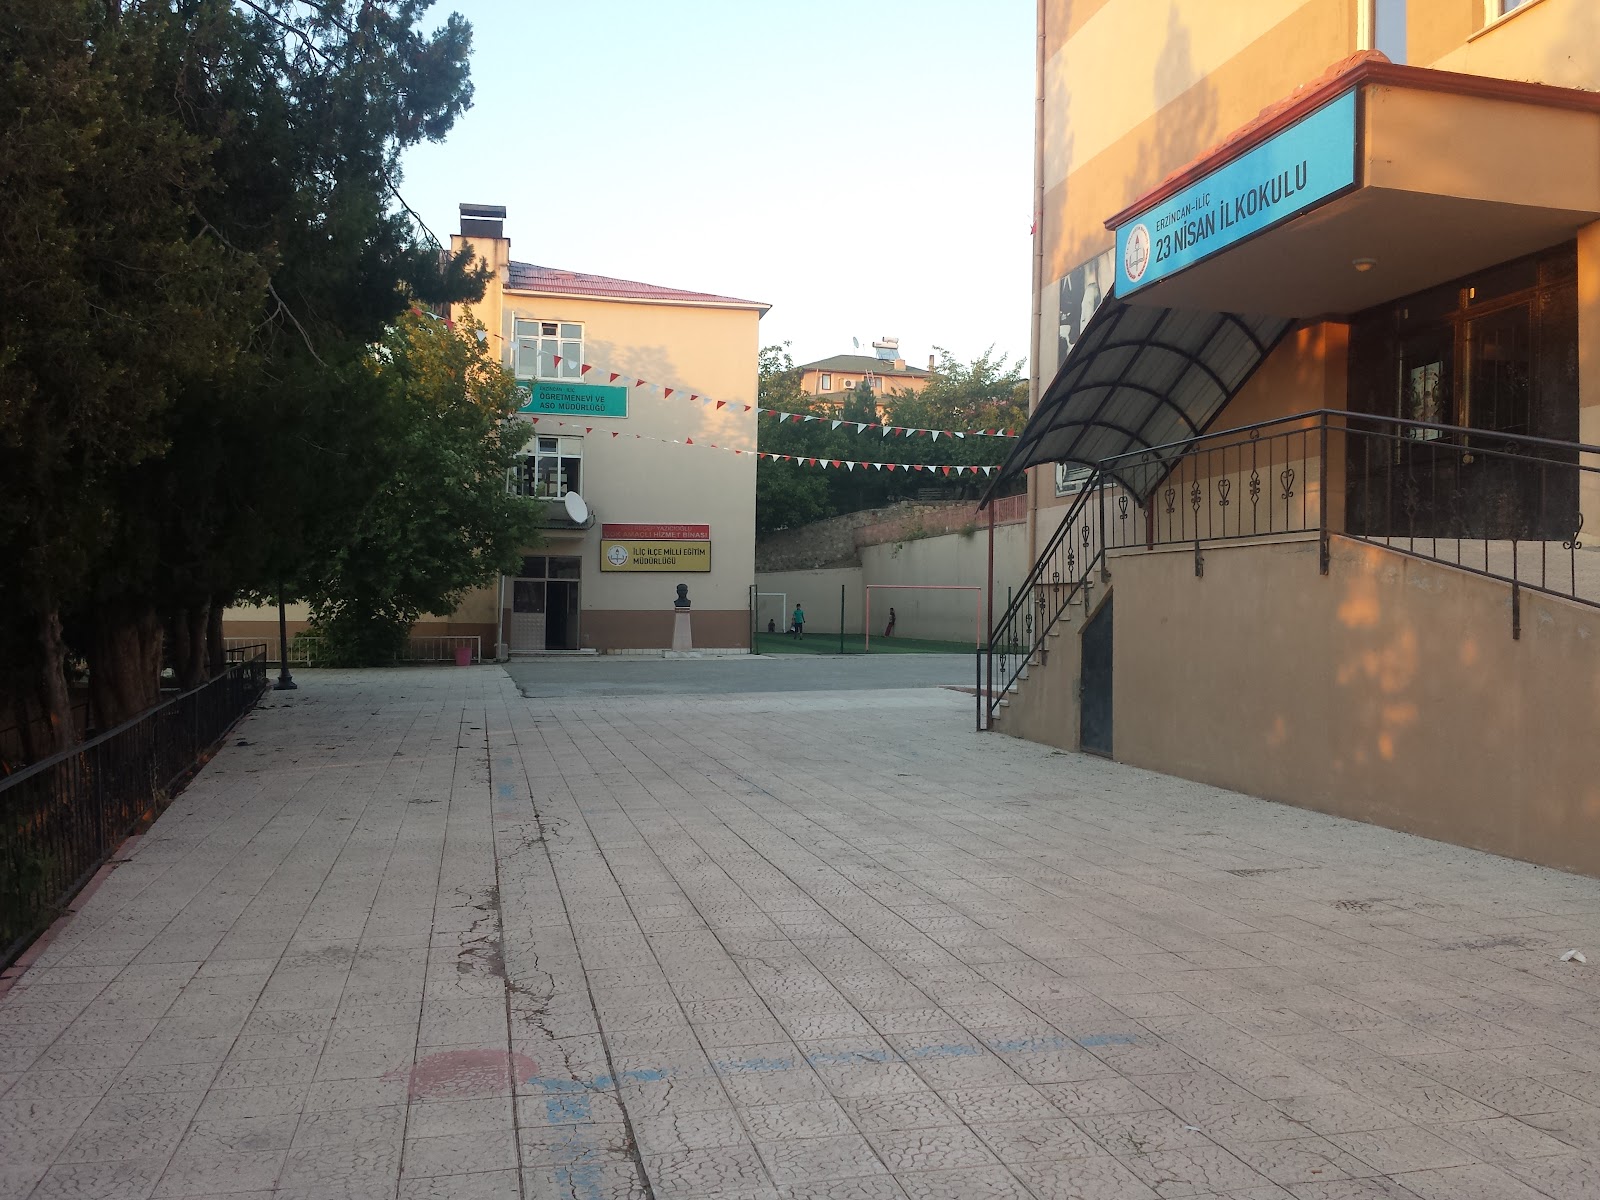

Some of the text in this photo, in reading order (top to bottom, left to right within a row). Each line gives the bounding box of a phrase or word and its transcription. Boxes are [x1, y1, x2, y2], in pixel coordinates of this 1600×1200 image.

[1155, 234, 1171, 264] 23
[1174, 209, 1215, 254] NİSAN
[1220, 160, 1307, 231] İLKOKULU
[540, 393, 593, 402] ÖĞRETMENEVİ
[558, 402, 605, 411] MÜDÜRLÜĞÜ
[682, 531, 708, 539] BİNASI
[633, 548, 646, 556] İLİÇ
[647, 548, 662, 556] İLÇE
[633, 556, 676, 565] MÜDÜRLÜĞÜ
